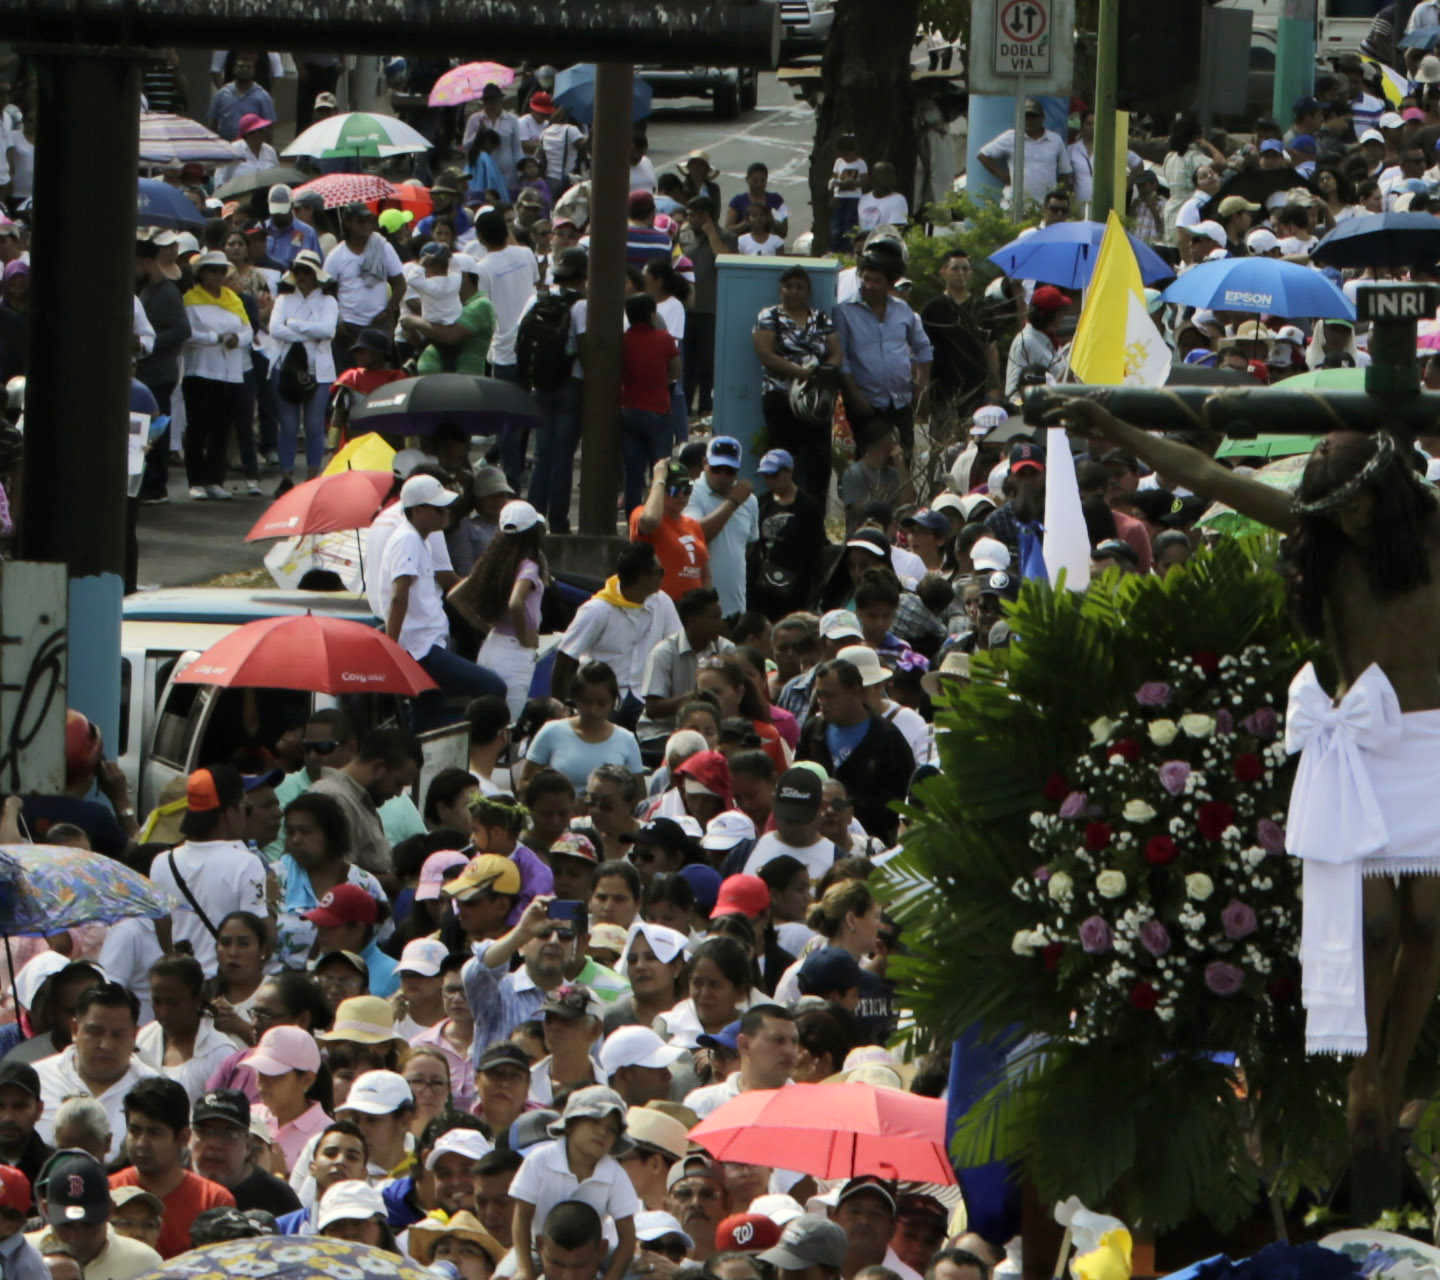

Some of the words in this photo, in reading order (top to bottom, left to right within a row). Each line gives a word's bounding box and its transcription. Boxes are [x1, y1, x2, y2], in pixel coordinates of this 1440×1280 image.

[999, 44, 1046, 58] DOBLE
[1012, 57, 1035, 71] VIA
[1224, 290, 1273, 305] EPSON
[1368, 292, 1426, 316] INRI
[732, 1221, 754, 1245] W
